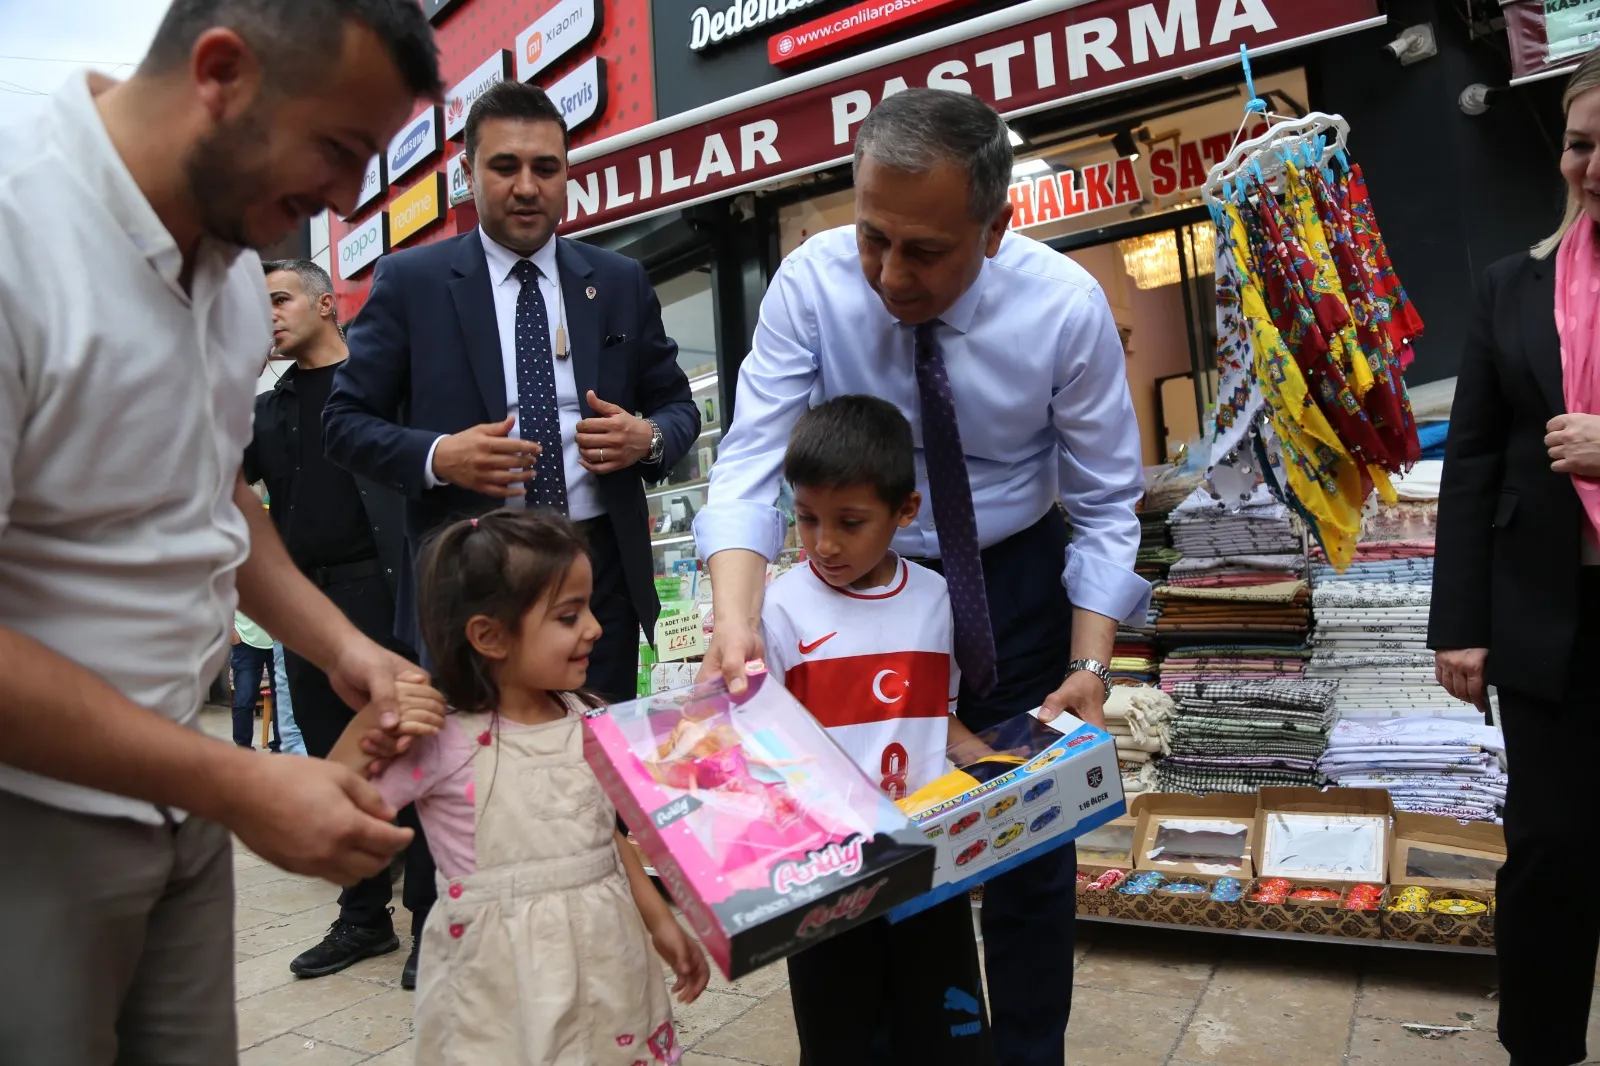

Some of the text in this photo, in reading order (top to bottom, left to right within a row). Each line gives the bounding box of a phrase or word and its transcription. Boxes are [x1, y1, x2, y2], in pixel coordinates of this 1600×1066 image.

[796, 0, 924, 44] www.canlilarpas
[466, 69, 500, 105] HUAWEI
[560, 82, 593, 118] Servis
[395, 130, 426, 161] SAMSUNG
[559, 118, 782, 224] NLILAR
[1008, 158, 1143, 230] HALKA
[394, 194, 432, 231] realme
[342, 226, 377, 262] oppo
[665, 624, 697, 637] SADE HELVA
